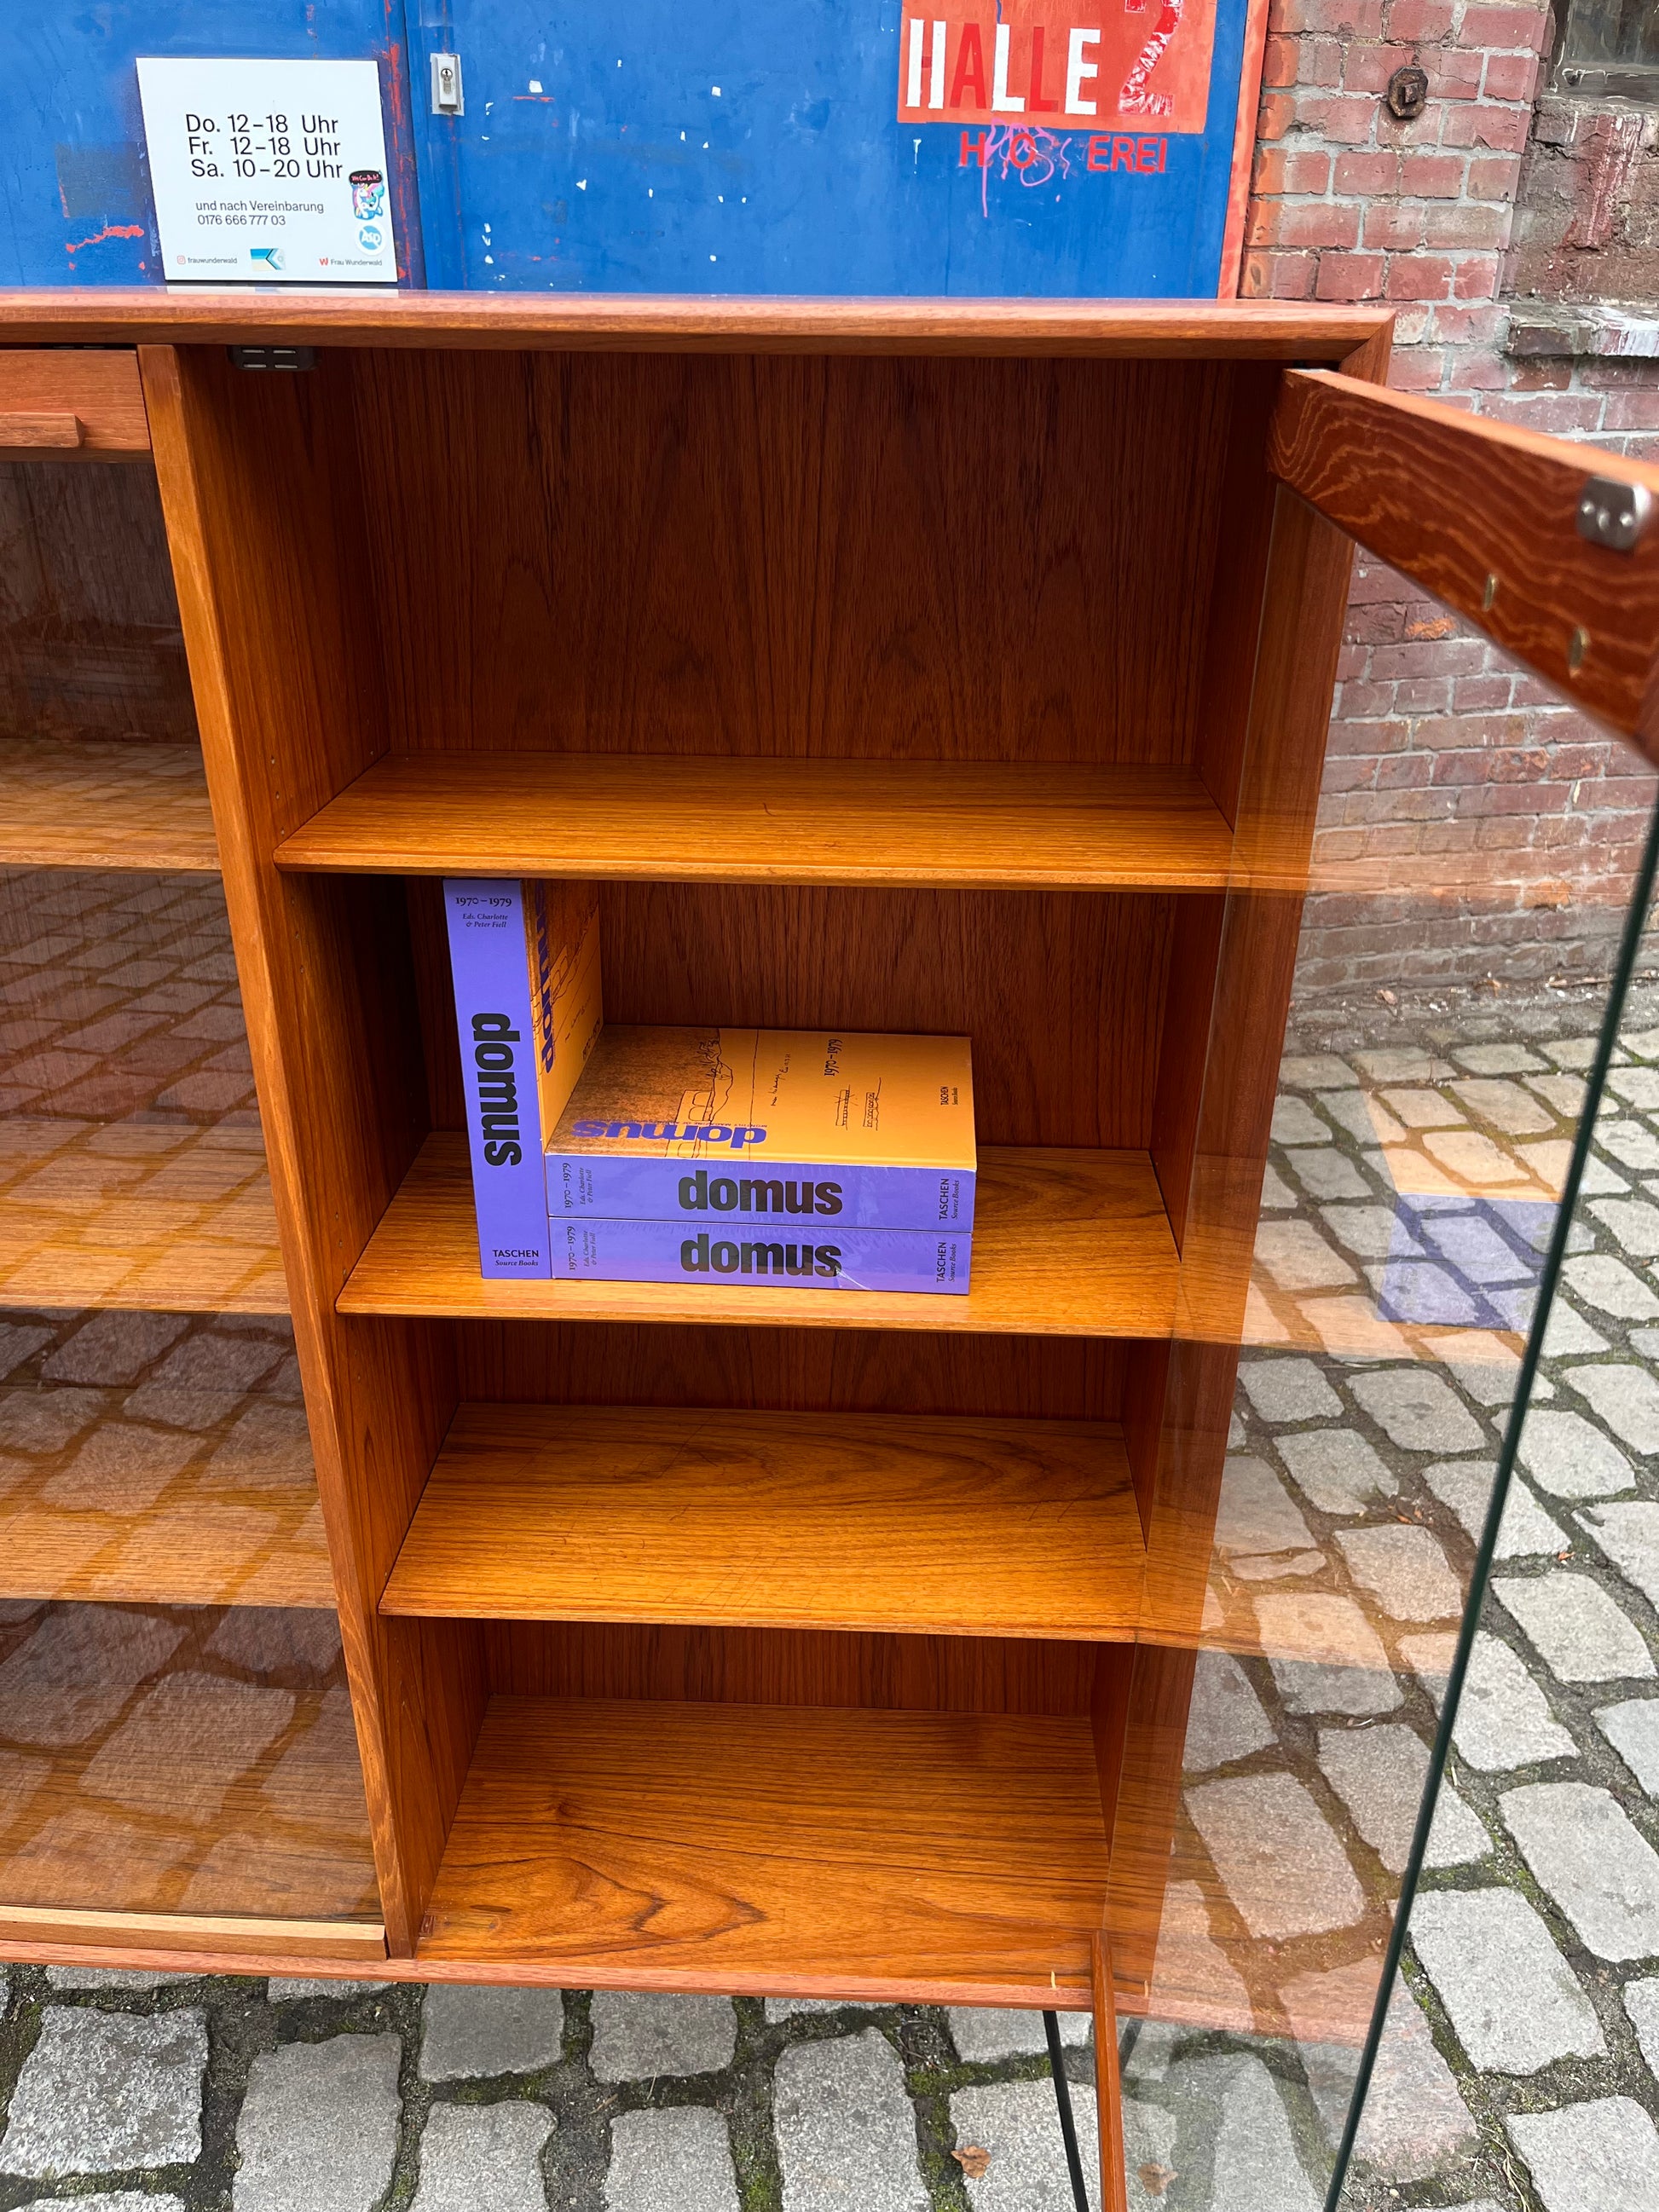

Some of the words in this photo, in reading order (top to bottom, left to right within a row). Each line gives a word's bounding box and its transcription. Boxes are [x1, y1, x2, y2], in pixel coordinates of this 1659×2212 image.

[905, 18, 1101, 115] HALLE
[186, 113, 221, 132] Do.
[301, 114, 338, 133] Uhr
[188, 136, 213, 155] Fr.
[303, 136, 341, 156] Uhr
[191, 159, 224, 177] Sa.
[306, 159, 343, 178] Uhr
[195, 200, 217, 211] und
[220, 200, 247, 211] nach
[249, 200, 324, 214] Vereinbarung
[197, 214, 223, 225] 0176
[225, 214, 247, 225] 666
[249, 215, 269, 225] 777
[271, 215, 286, 226] 03
[471, 1013, 523, 1167] domus
[571, 1119, 767, 1149] domus
[678, 1170, 843, 1216] domus
[939, 1178, 950, 1221] TASCHEN
[492, 1249, 540, 1258] TASCHEN
[680, 1233, 842, 1278] domus
[936, 1242, 947, 1283] TASCHEN
